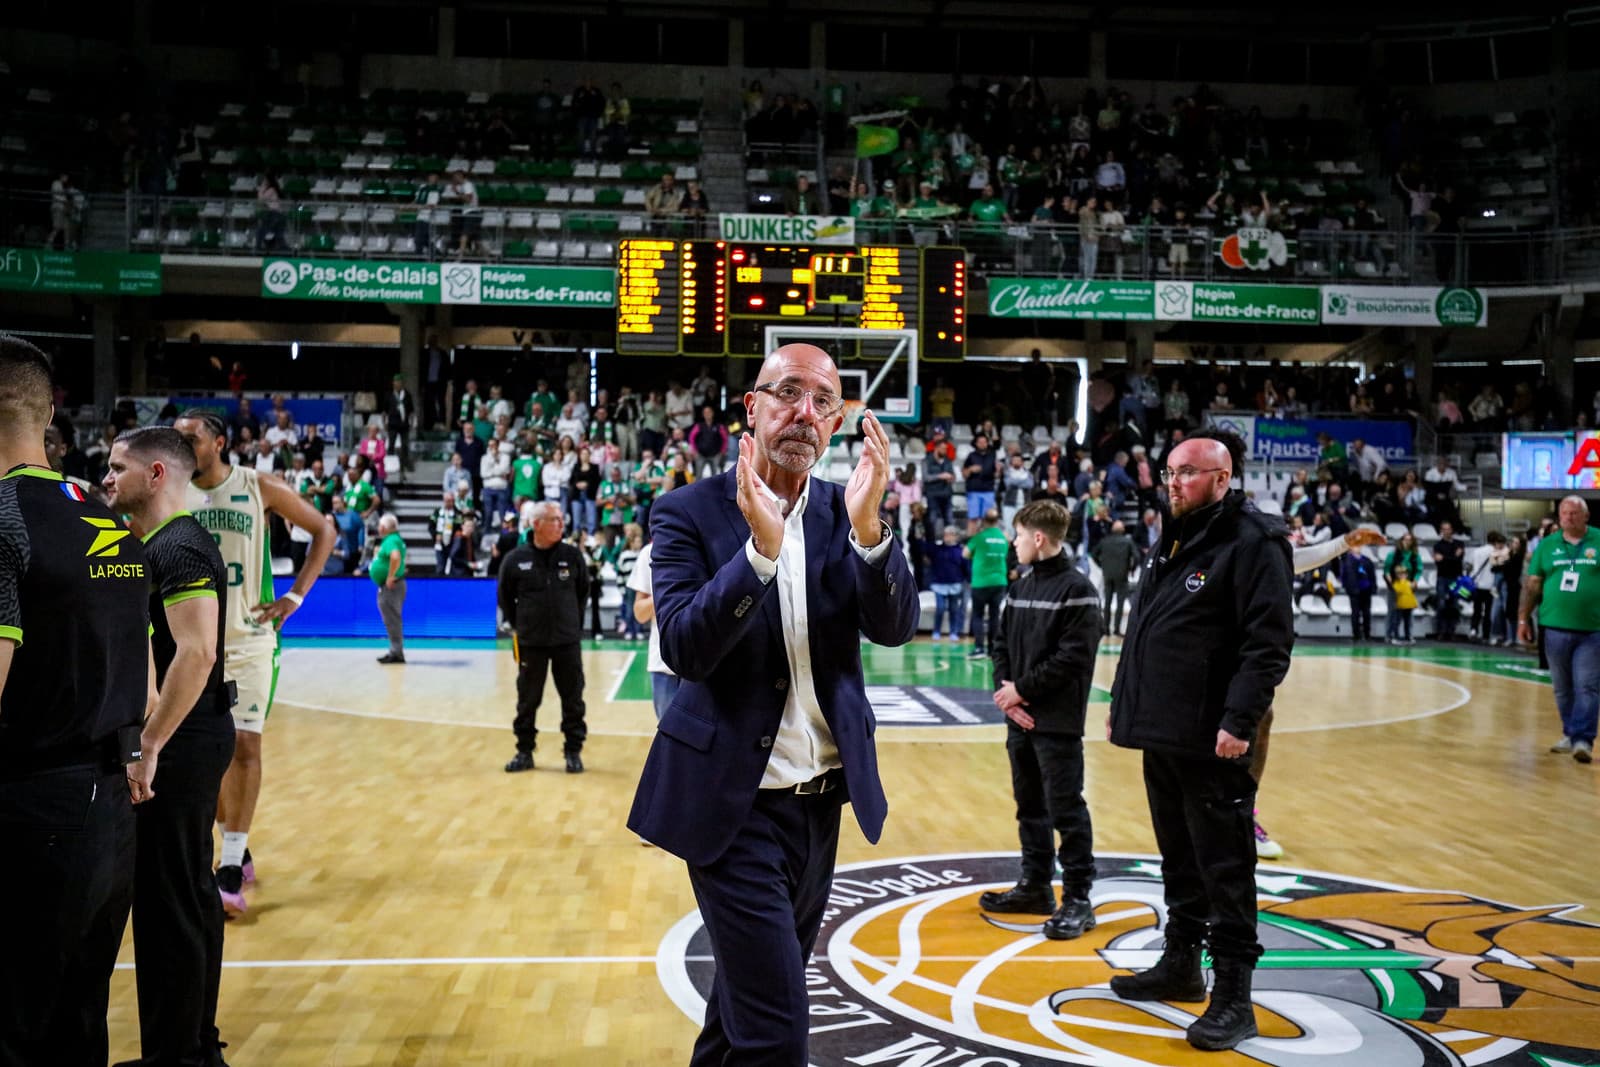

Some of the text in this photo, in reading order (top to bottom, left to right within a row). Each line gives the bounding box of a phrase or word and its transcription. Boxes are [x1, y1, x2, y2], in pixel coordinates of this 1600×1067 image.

[724, 218, 817, 241] DUNKERS
[268, 269, 291, 285] 62
[483, 270, 526, 284] Région
[342, 286, 423, 301] Département
[482, 285, 612, 302] Hauts-de-France
[1194, 287, 1236, 301] Région
[1194, 303, 1317, 320] Hauts-de-France
[1355, 301, 1432, 314] Boulonnais
[89, 564, 144, 578] LA POSTE
